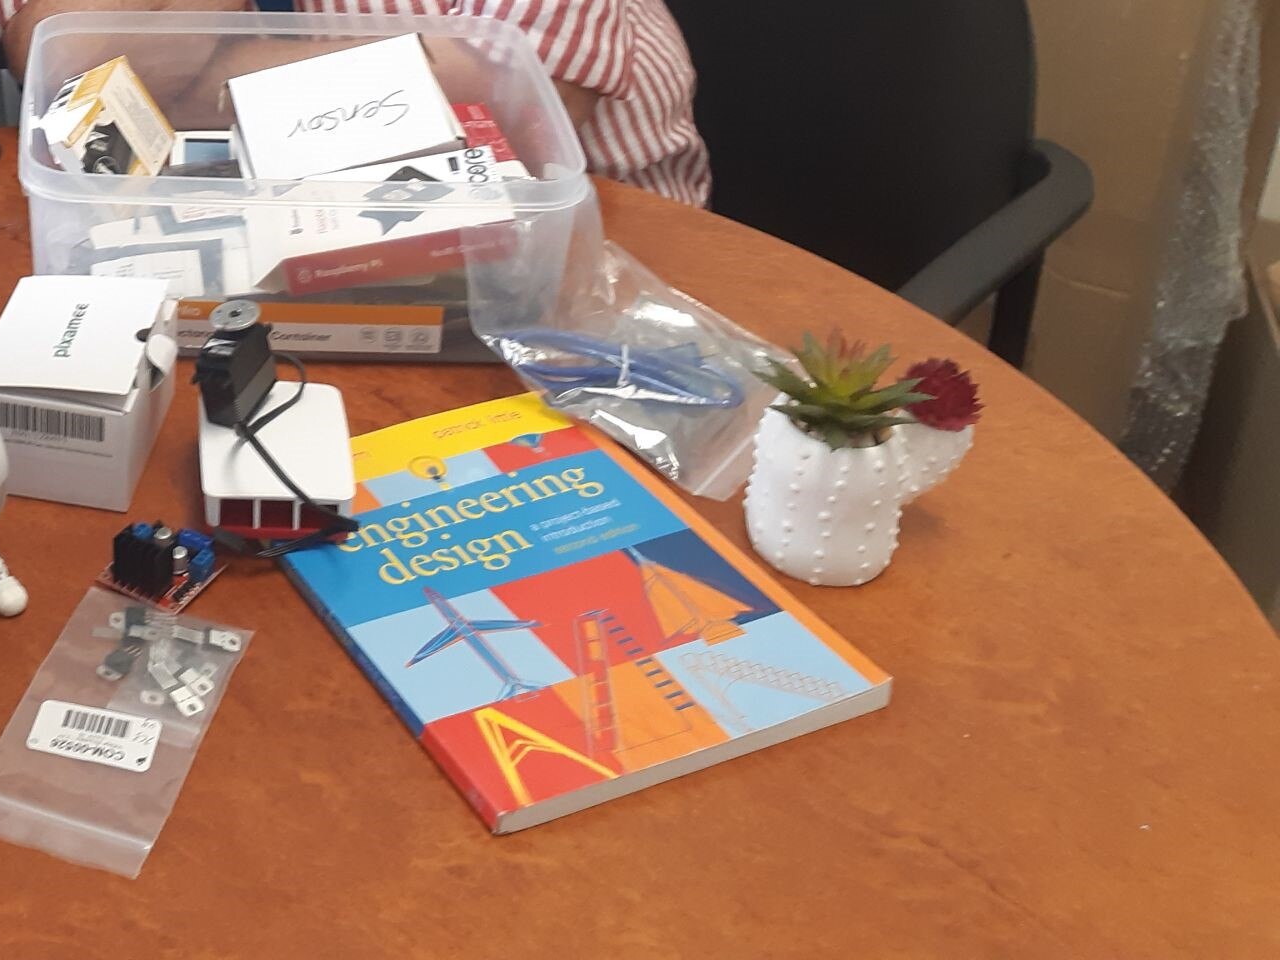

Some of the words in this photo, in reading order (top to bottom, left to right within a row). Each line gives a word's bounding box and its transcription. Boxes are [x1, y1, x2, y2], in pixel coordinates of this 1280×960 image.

[287, 89, 410, 138] Sensor
[336, 466, 606, 553] engineering
[377, 528, 534, 586] design
